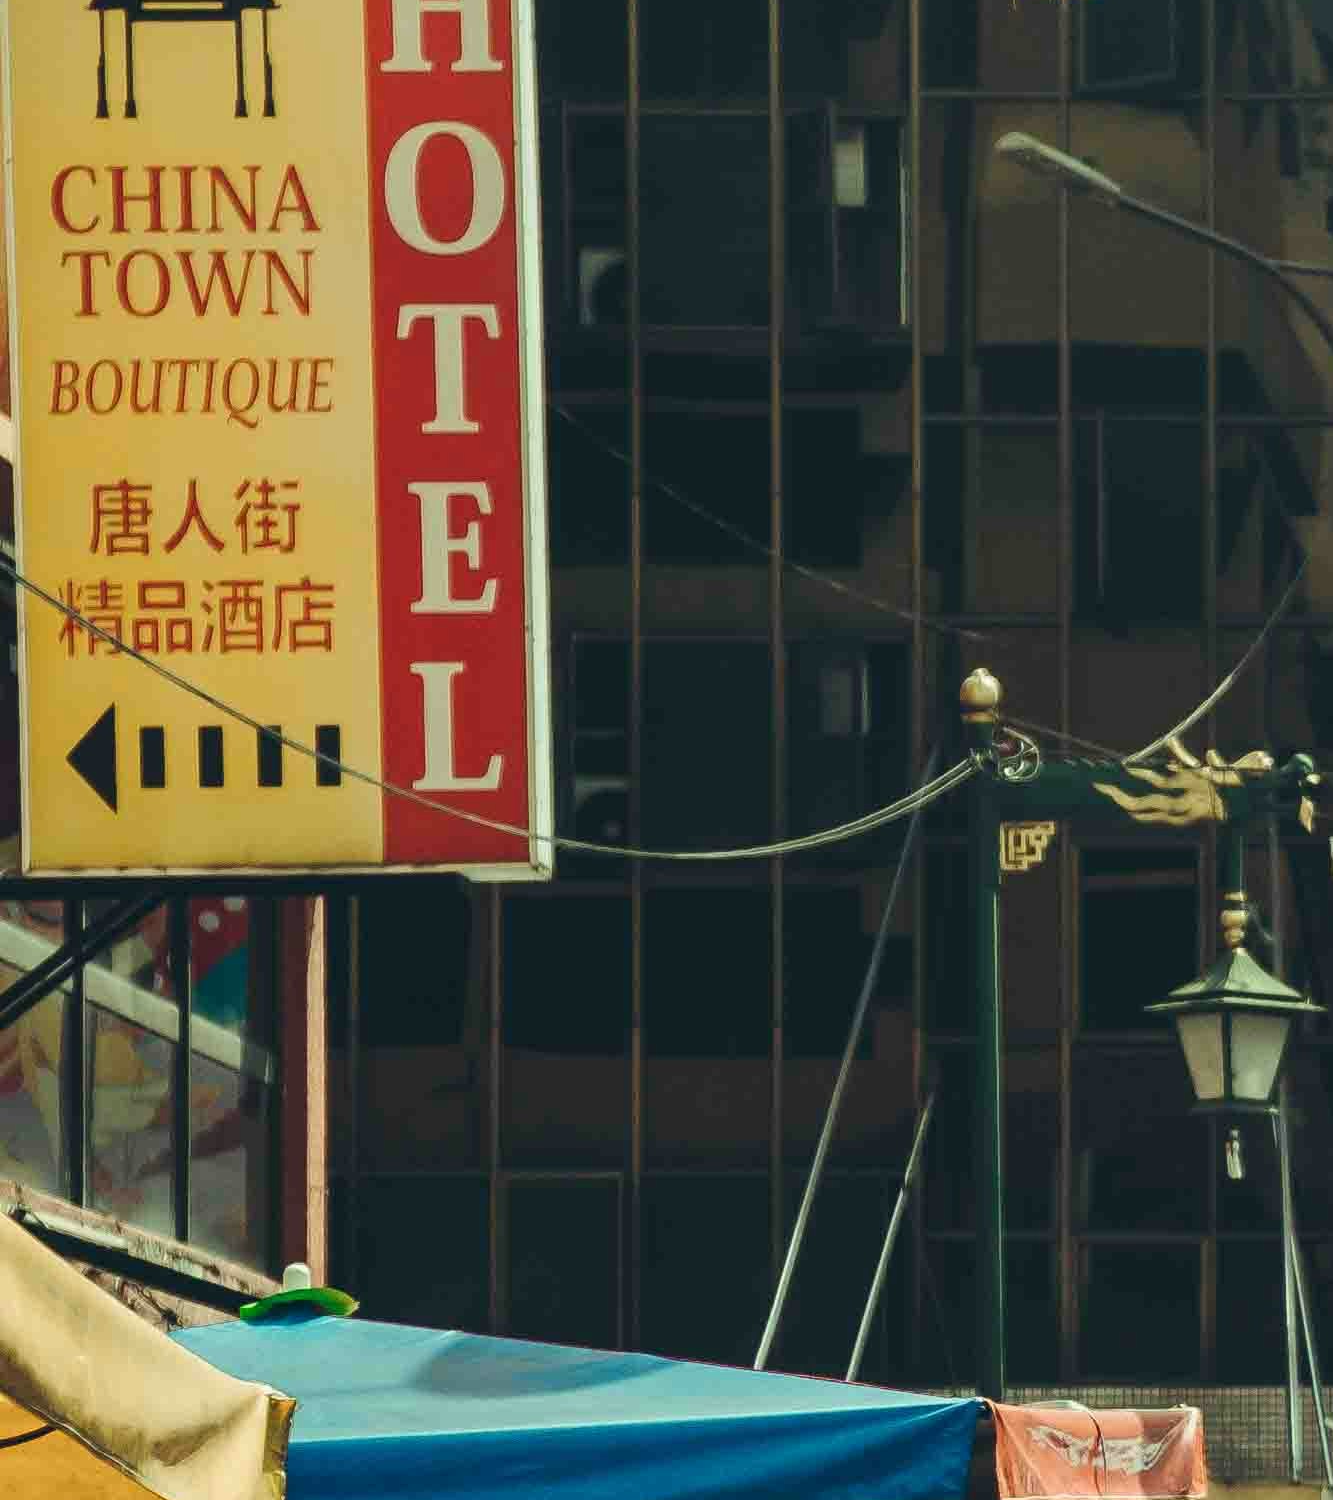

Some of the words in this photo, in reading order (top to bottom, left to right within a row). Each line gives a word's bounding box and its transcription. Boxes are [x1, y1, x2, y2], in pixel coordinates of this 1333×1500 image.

[50, 164, 321, 235] CHINA
[61, 250, 315, 318] TOWN
[48, 357, 335, 428] BOUTIQUE
[88, 479, 300, 556] 唐人街
[57, 578, 334, 655] 精品酒店
